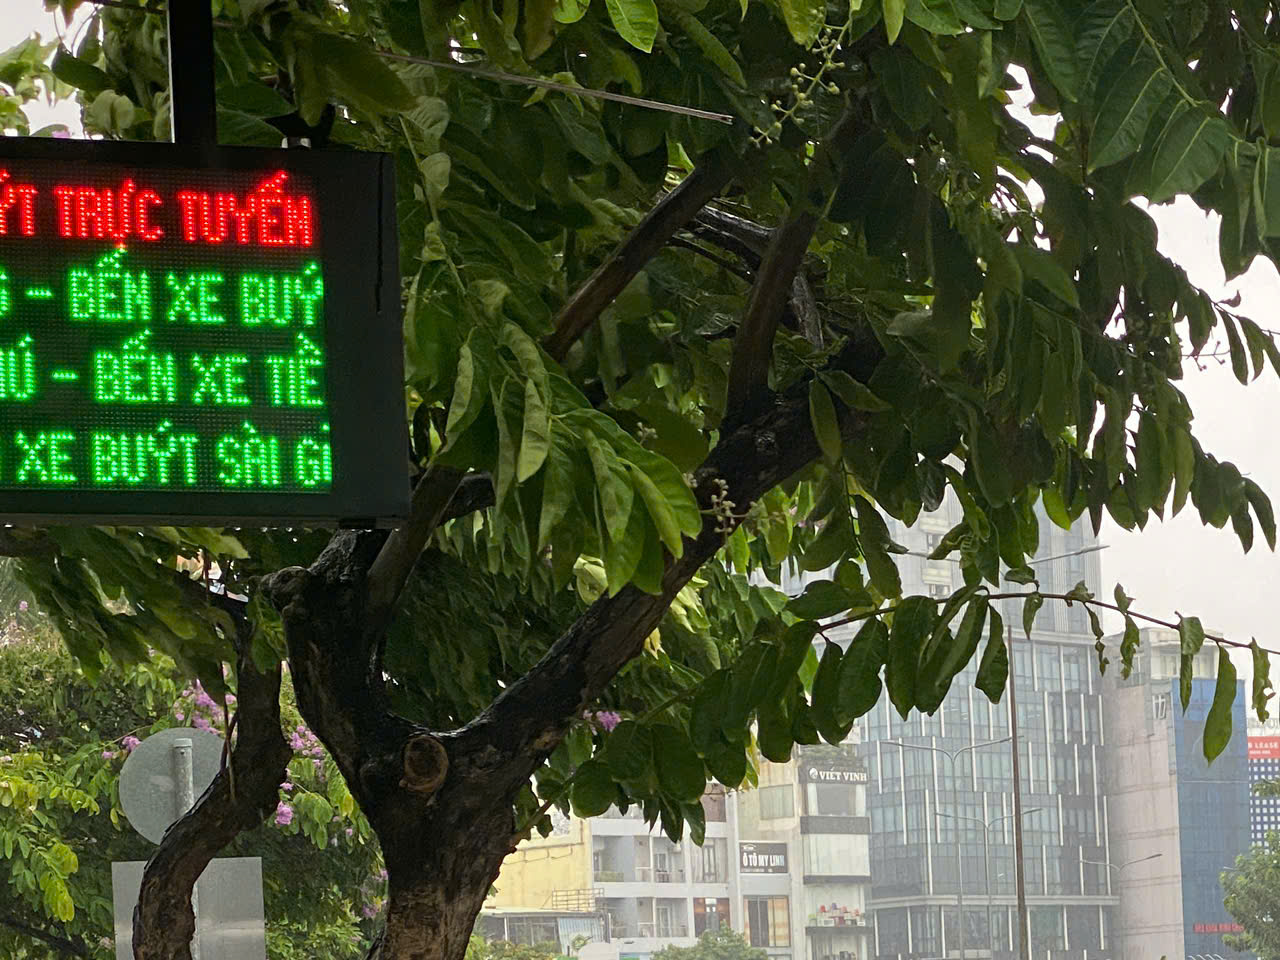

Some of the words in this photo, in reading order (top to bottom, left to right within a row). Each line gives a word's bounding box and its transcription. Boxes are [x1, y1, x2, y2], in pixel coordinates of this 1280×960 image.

[177, 169, 313, 247] TUYẾN
[68, 248, 152, 320] BẾN
[166, 271, 226, 324] XE
[94, 327, 178, 403] BẾN
[192, 352, 251, 406] XE
[16, 430, 78, 483] XE
[93, 419, 199, 485] BUÝT
[217, 420, 280, 487] SÀI
[294, 423, 332, 488] G
[843, 771, 867, 782] VINH
